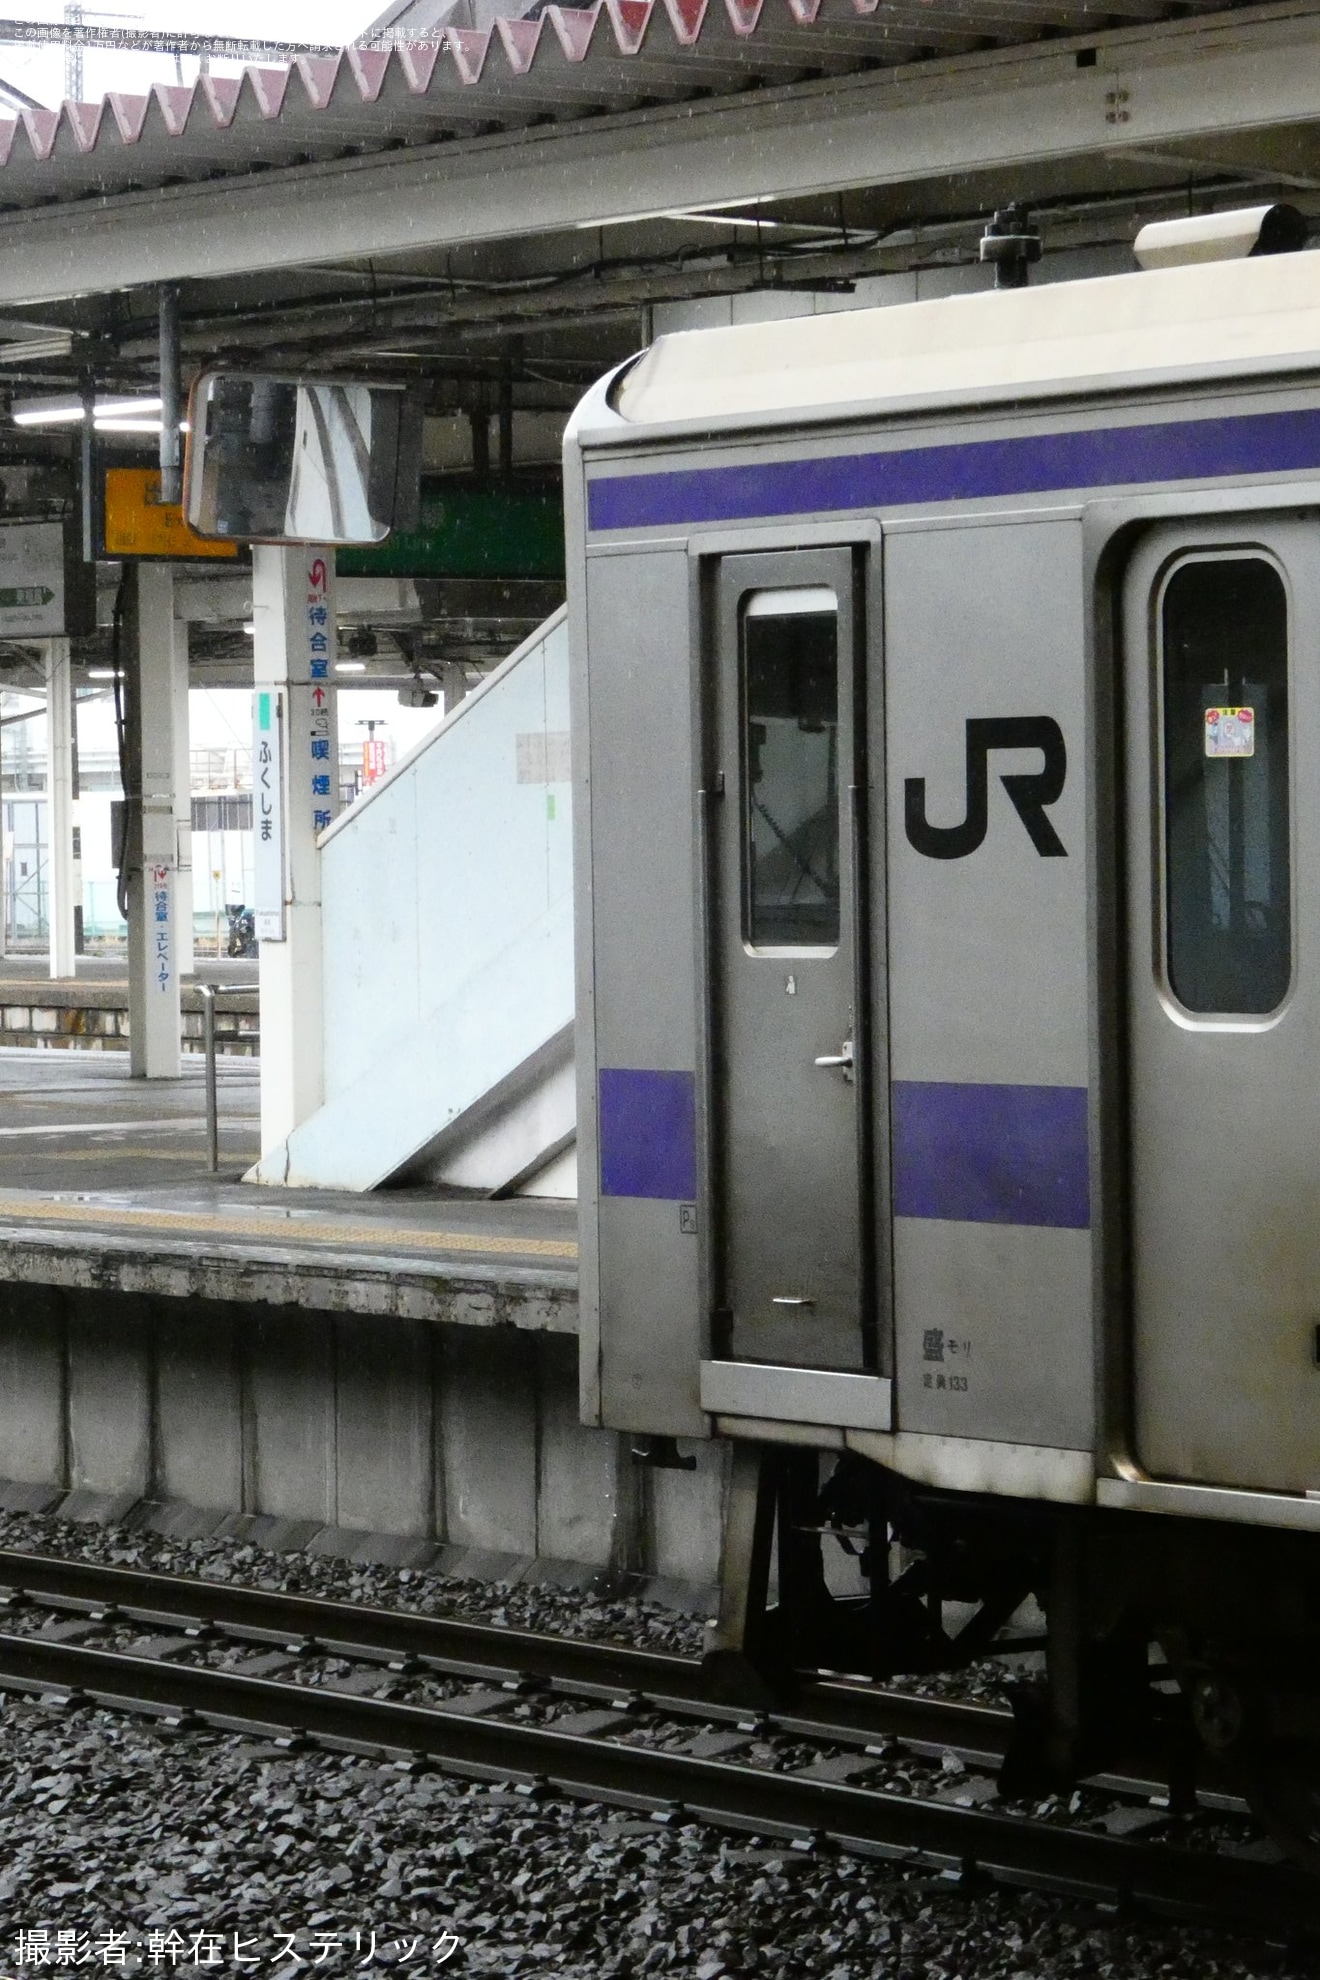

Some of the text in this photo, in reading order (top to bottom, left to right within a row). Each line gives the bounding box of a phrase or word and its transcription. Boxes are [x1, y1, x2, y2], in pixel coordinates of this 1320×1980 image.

[309, 606, 328, 678] 待合室
[259, 741, 272, 841] ふくしま
[310, 738, 331, 829] 喫煙所
[904, 715, 1069, 860] JR
